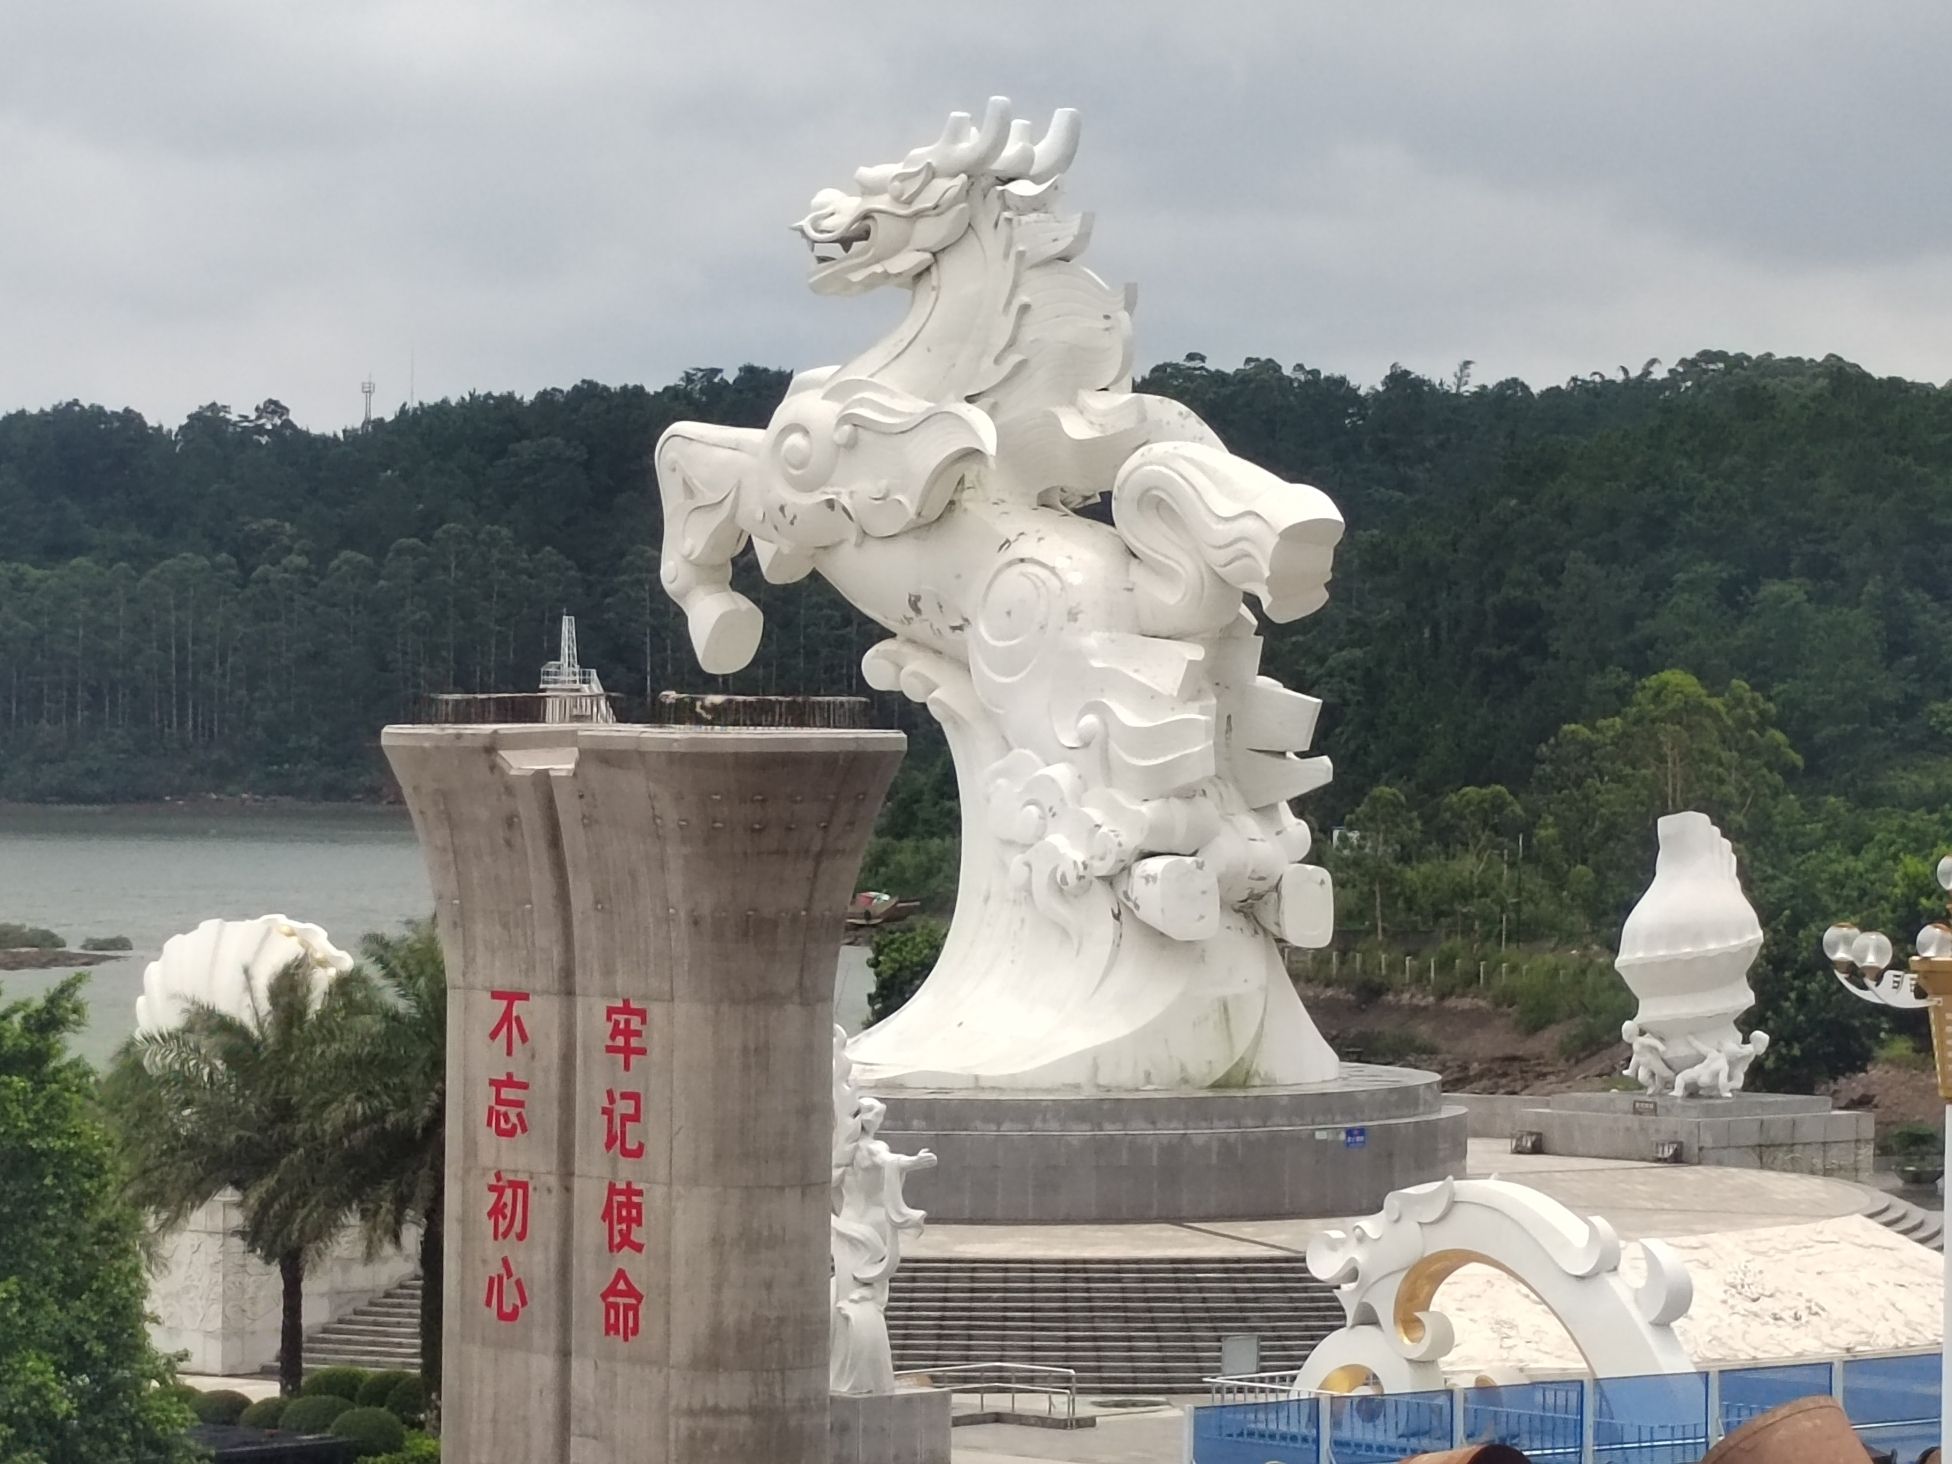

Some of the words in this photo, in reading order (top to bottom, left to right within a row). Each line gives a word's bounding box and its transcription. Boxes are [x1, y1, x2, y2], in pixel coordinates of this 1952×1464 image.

[485, 990, 530, 1324] 不忘初心
[601, 999, 648, 1343] 牢记使命
